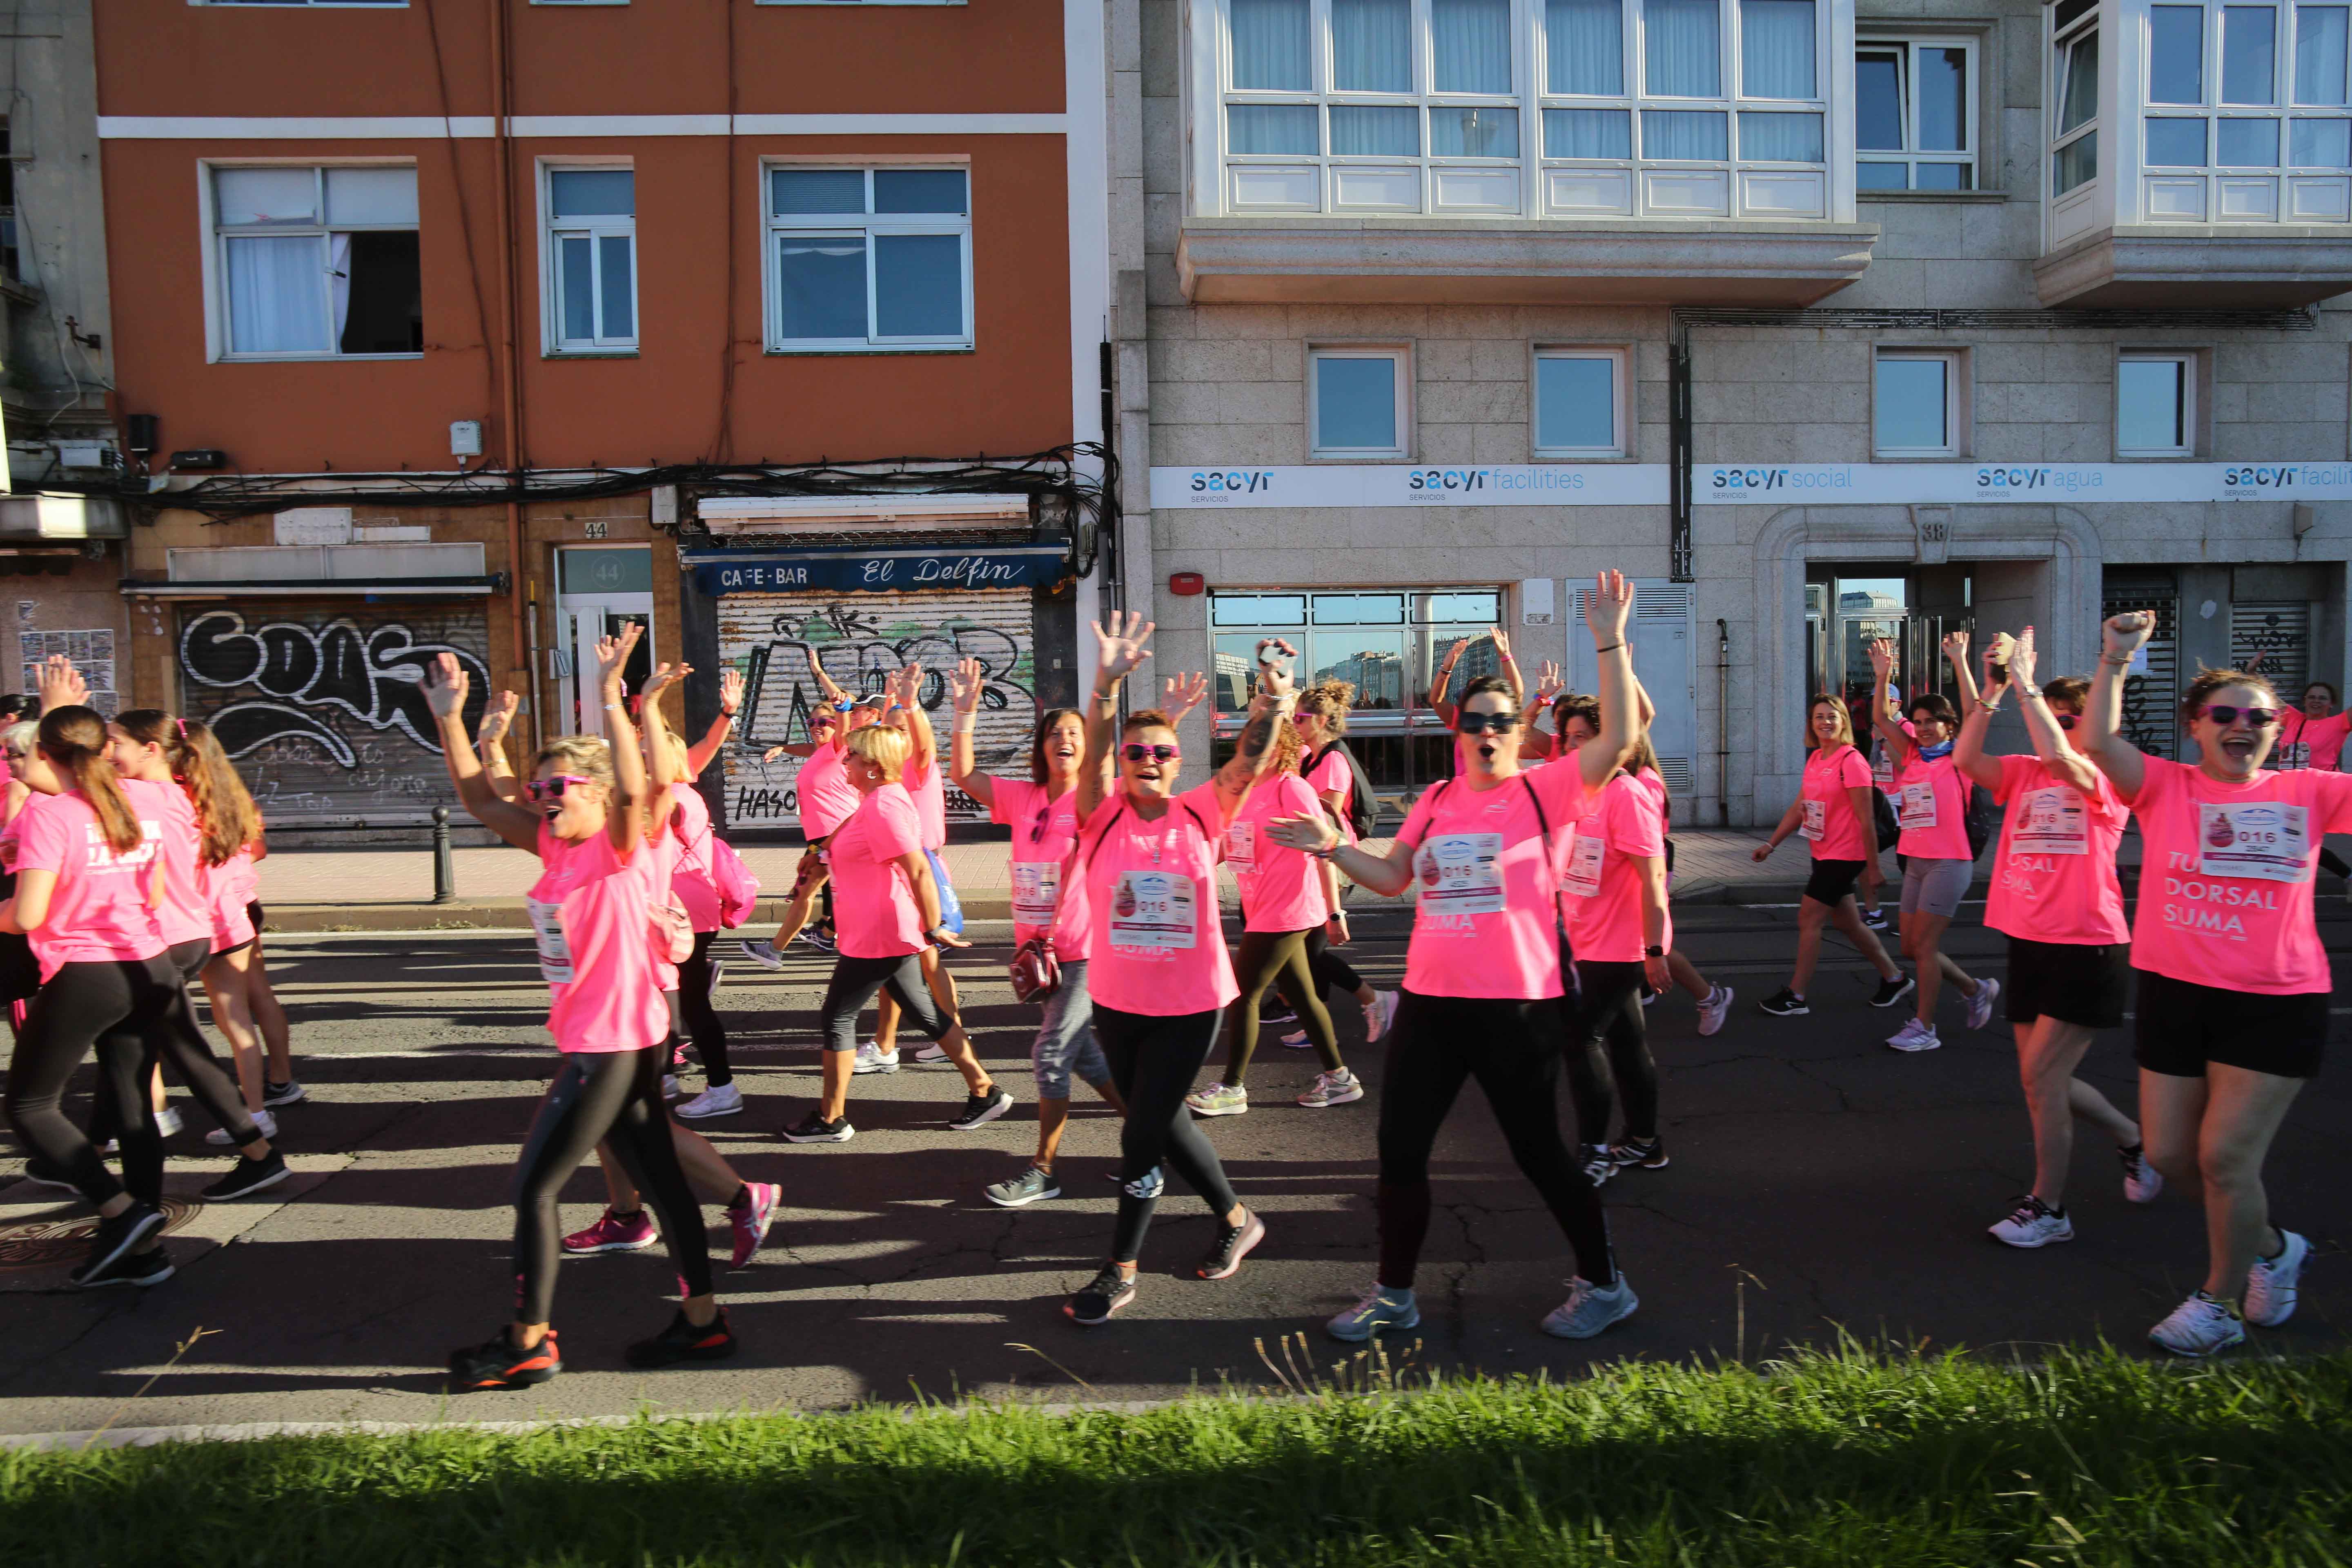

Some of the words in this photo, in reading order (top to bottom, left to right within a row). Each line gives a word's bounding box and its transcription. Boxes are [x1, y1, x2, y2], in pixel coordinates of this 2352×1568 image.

[1191, 472, 1274, 493] sacyr
[1410, 470, 1489, 492] sacyr
[1493, 468, 1584, 489] facilities
[1713, 469, 1789, 490] sacyr
[1792, 468, 1853, 487] social
[1977, 469, 2051, 489] sacyr
[2054, 471, 2103, 492] agua
[2225, 468, 2298, 487] sacyr
[586, 523, 607, 538] 44
[1922, 522, 1945, 542] 38
[596, 564, 619, 581] 44
[860, 560, 893, 582] El
[913, 557, 1025, 586] Delfin
[2238, 831, 2277, 843] 016
[2165, 877, 2278, 910] DORSAL
[2164, 903, 2245, 933] SUMA
